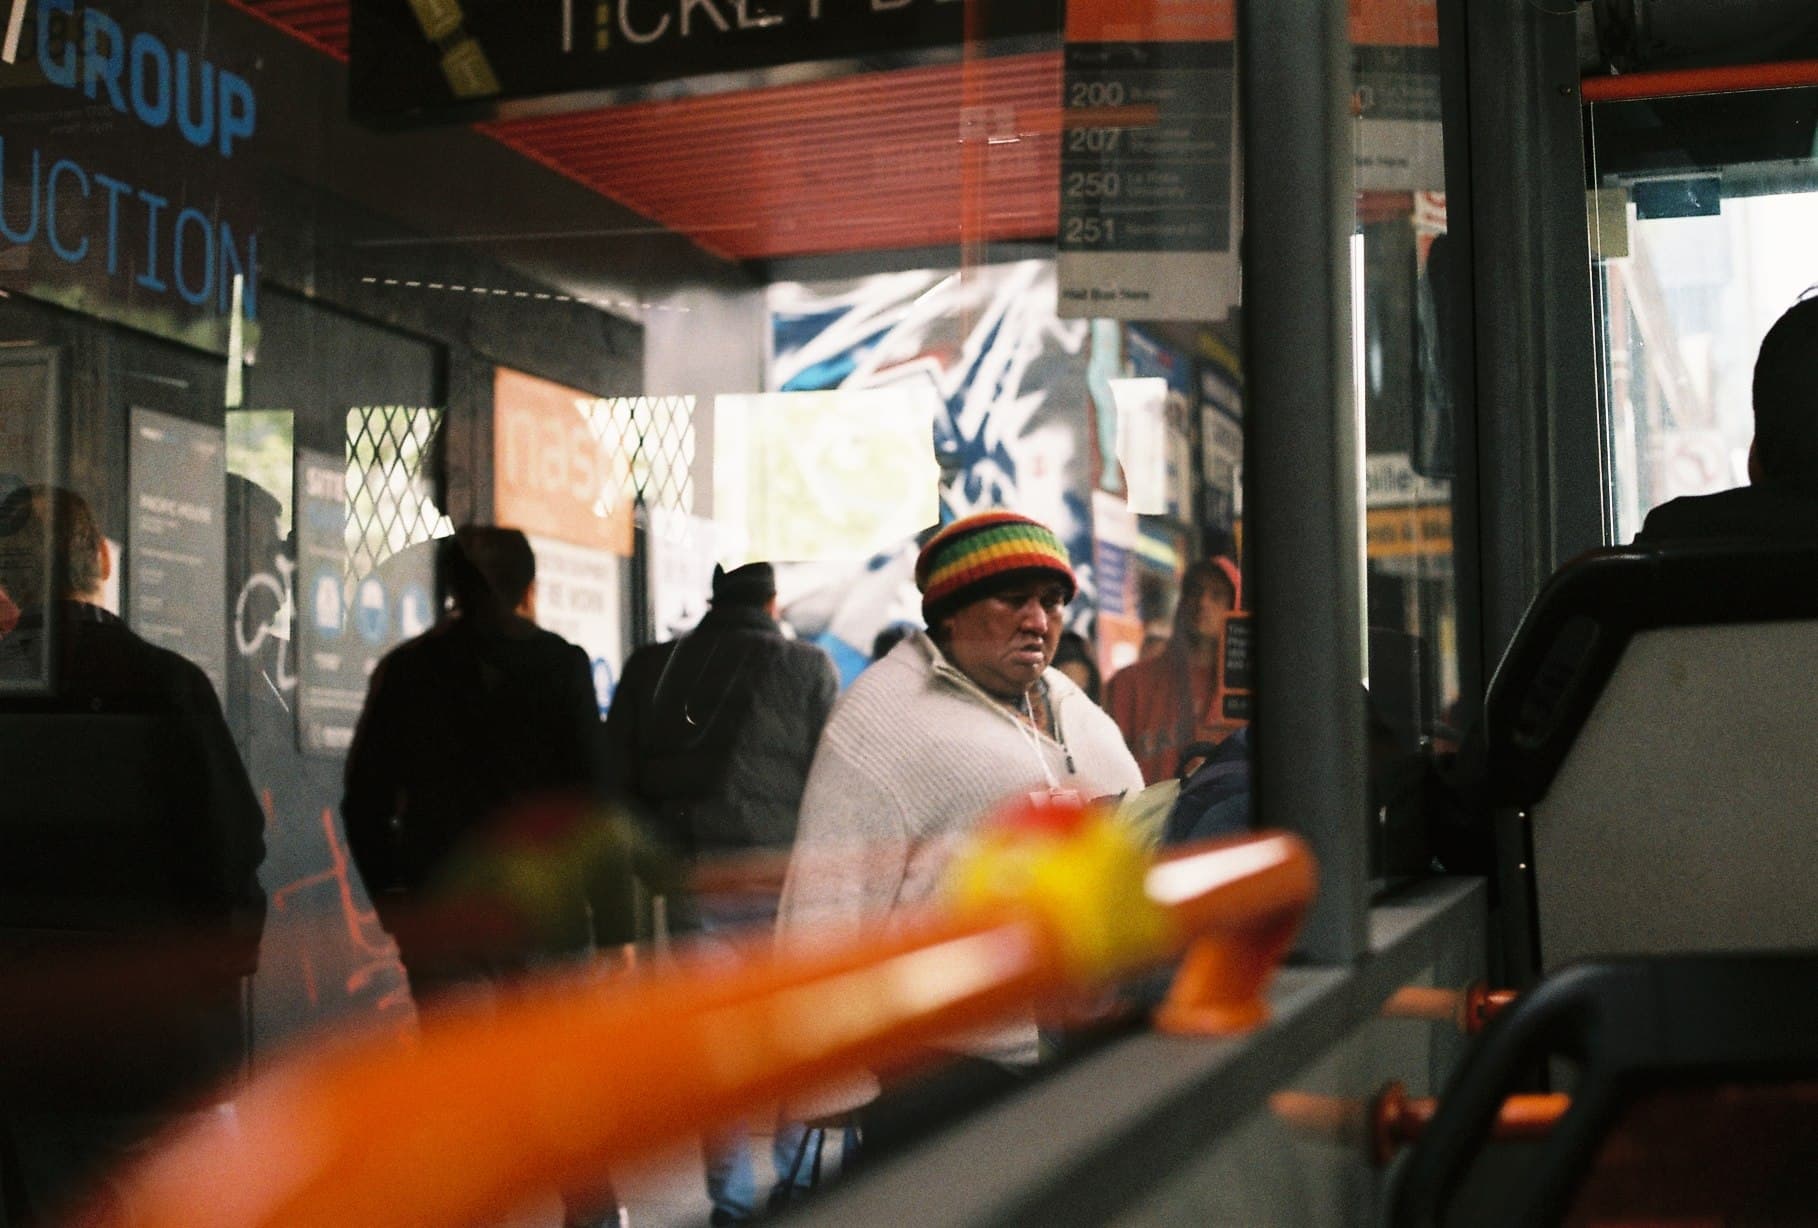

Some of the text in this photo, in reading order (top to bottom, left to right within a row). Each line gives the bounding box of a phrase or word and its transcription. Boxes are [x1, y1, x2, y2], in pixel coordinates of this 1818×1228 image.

[36, 0, 257, 158] GROUP
[1071, 81, 1124, 107] 200
[1069, 127, 1121, 151] 207
[1066, 171, 1120, 197] 250
[0, 136, 257, 321] UCTION
[1065, 217, 1118, 242] 251
